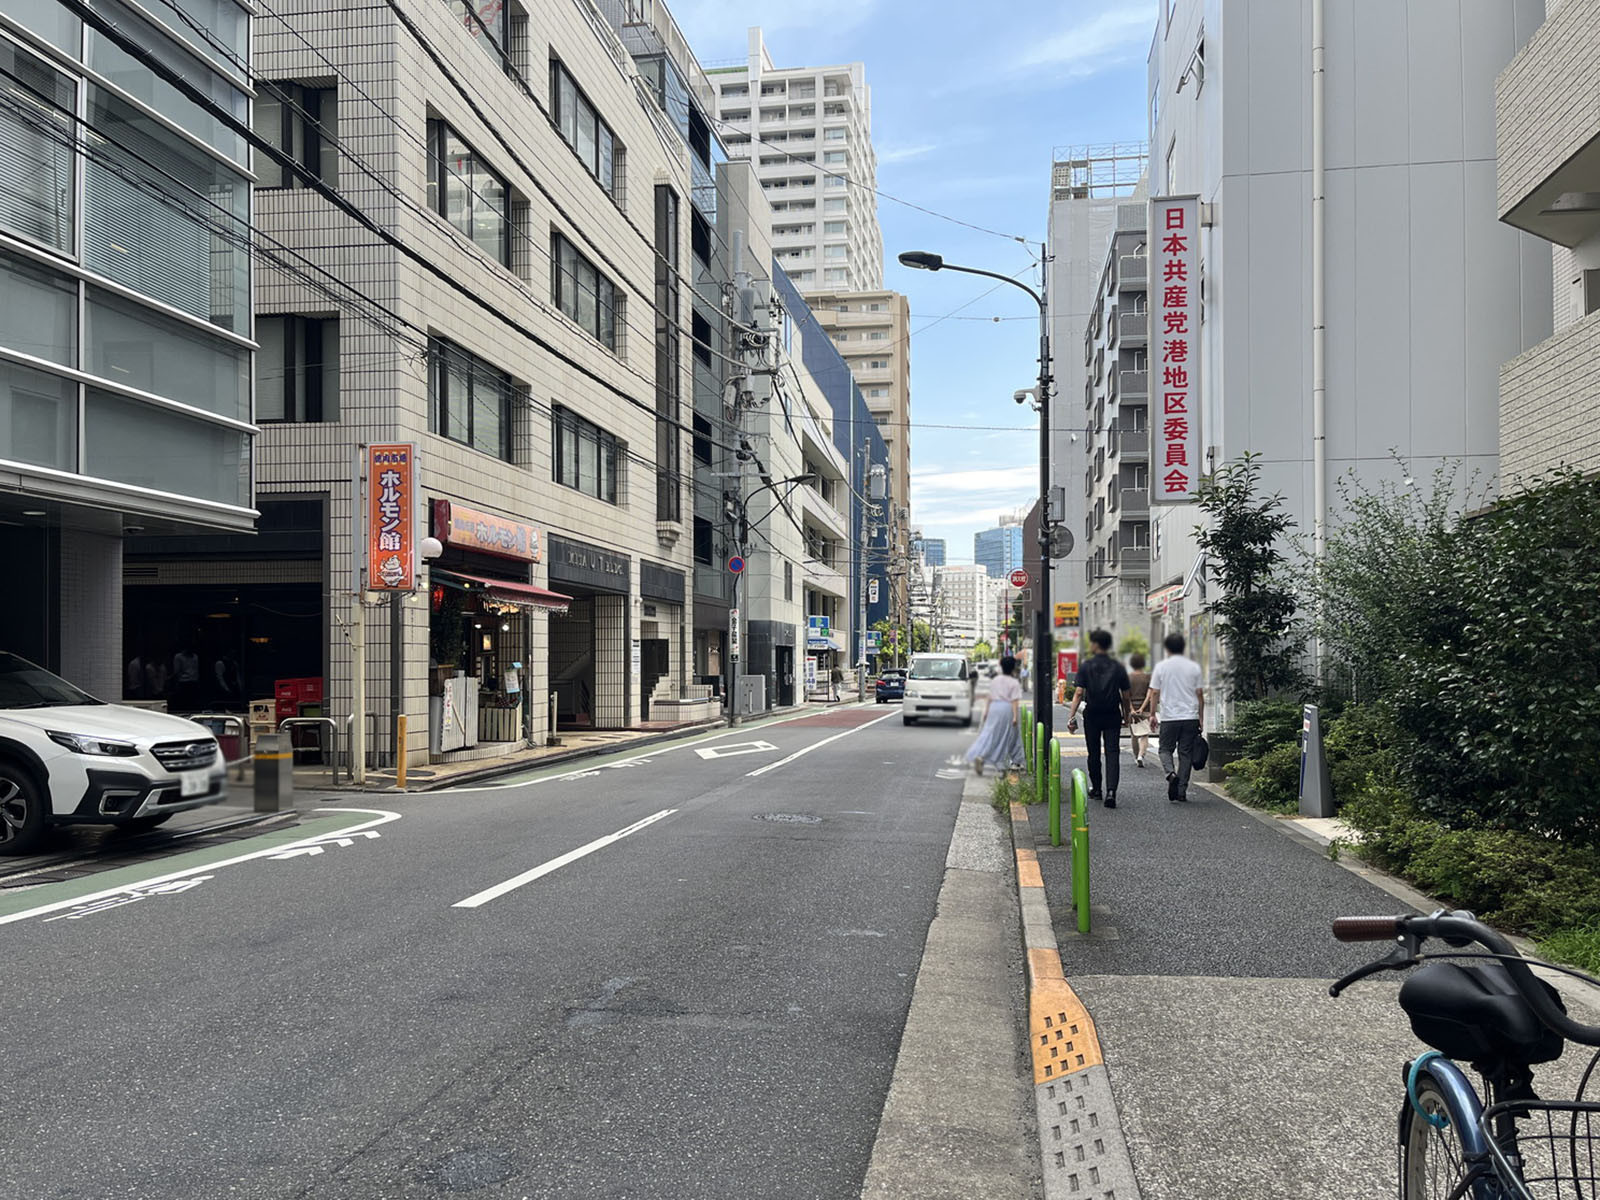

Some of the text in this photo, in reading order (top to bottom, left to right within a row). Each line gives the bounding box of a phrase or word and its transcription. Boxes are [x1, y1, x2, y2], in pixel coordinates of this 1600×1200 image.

[1162, 207, 1189, 493] 日本共産党港地区委員会
[378, 470, 402, 551] ホルモン館
